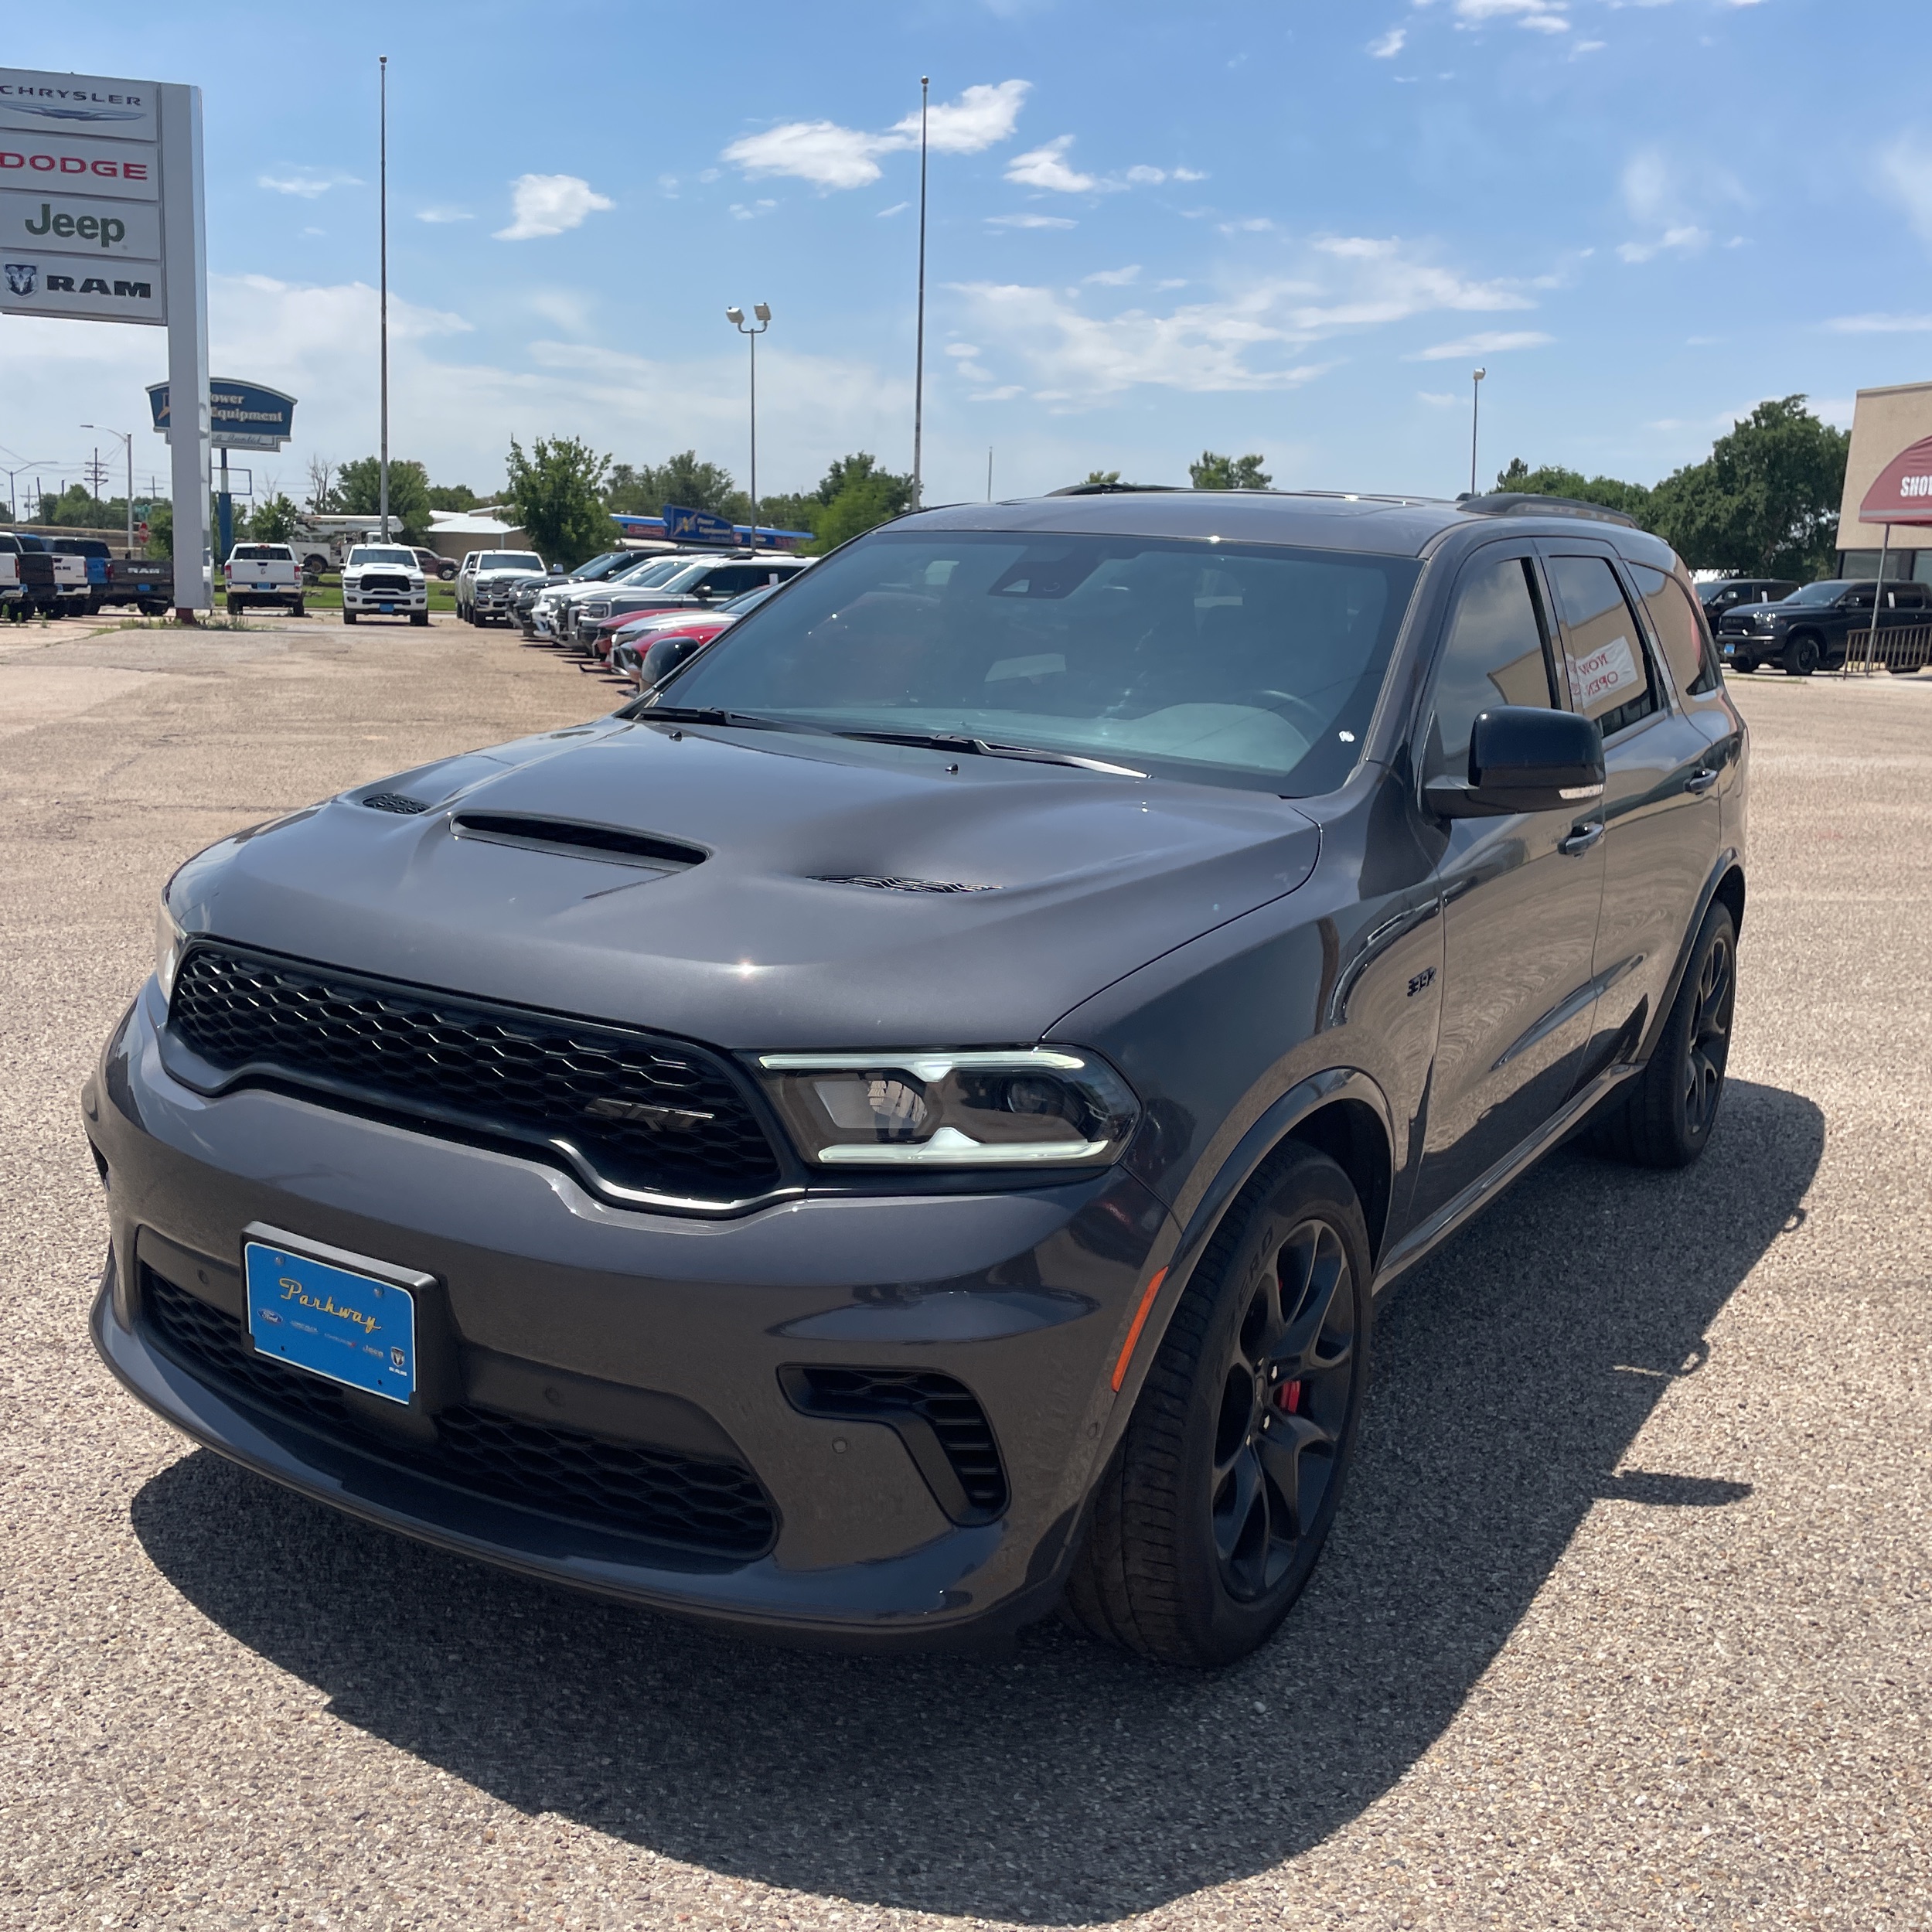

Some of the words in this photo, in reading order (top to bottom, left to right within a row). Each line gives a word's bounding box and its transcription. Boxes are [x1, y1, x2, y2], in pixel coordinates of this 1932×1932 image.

[0, 85, 141, 106] CHRYSLER
[0, 152, 148, 180] DODGE
[25, 203, 126, 247] Jeep
[46, 274, 152, 298] RAM
[210, 394, 245, 404] ower
[211, 407, 283, 422] Equipment
[278, 1277, 382, 1334] Parkway
